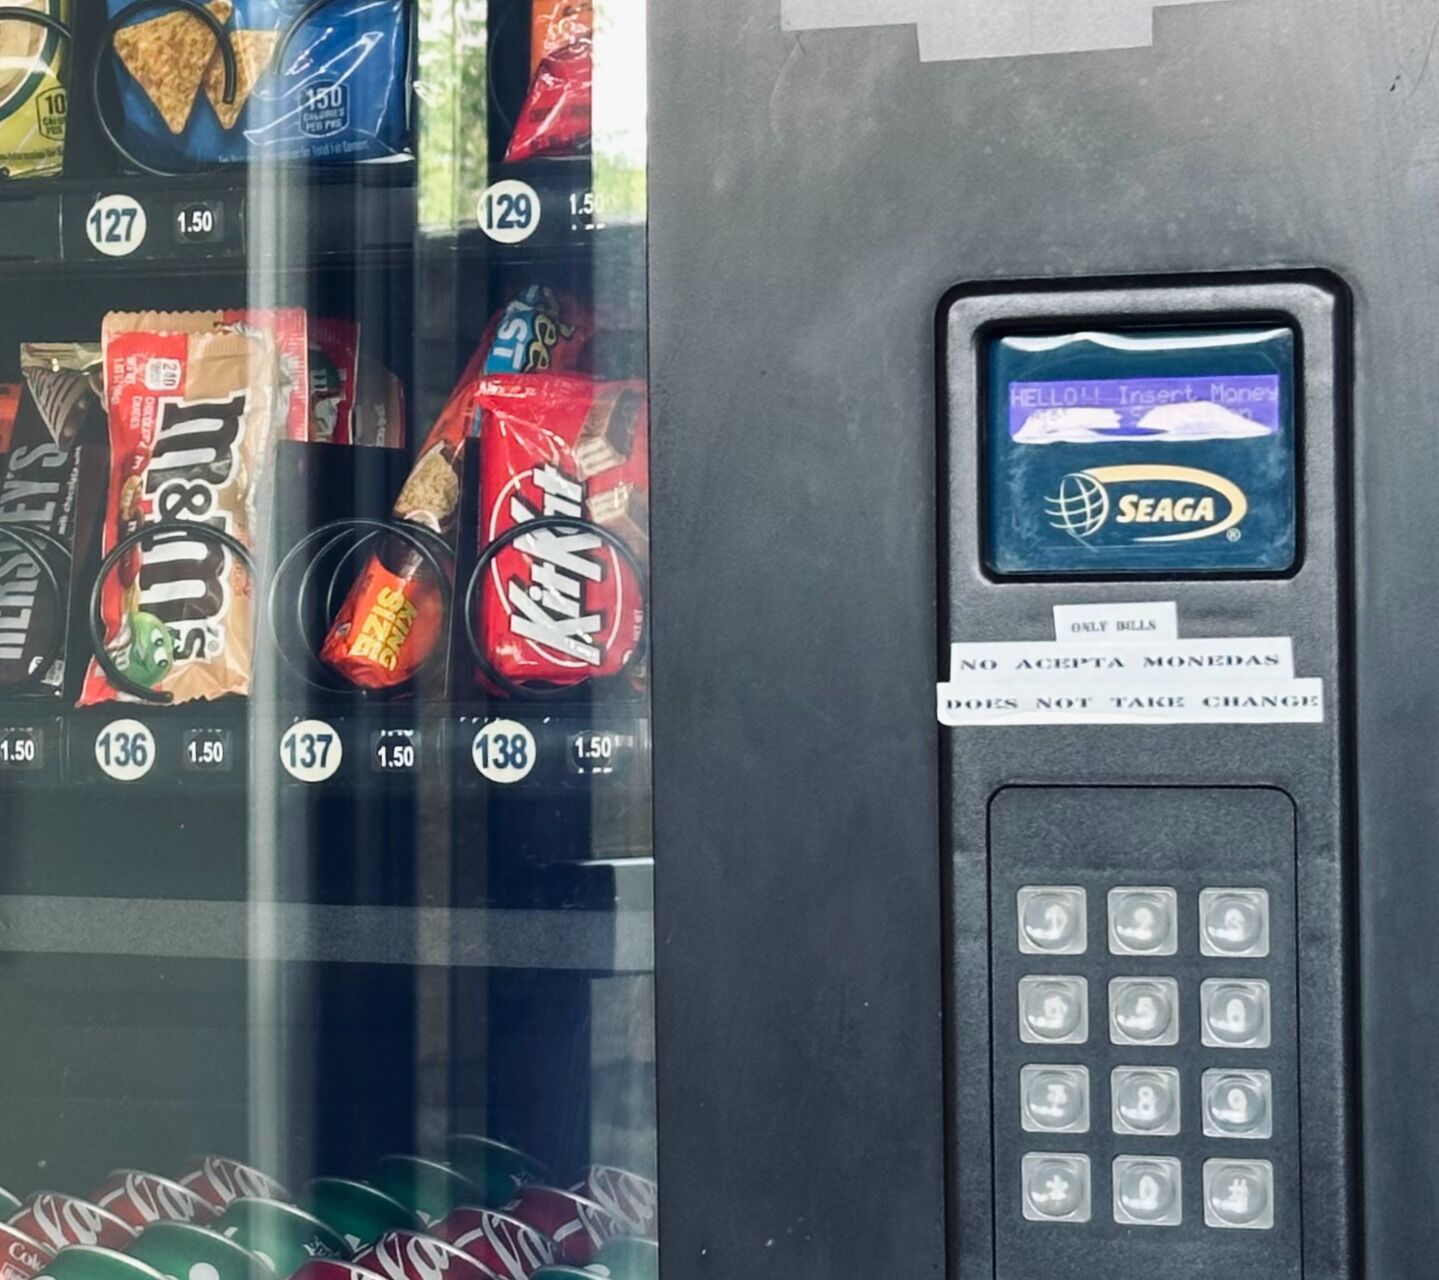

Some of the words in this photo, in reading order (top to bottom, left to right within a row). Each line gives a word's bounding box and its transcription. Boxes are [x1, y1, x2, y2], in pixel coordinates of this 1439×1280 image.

[178, 210, 213, 232] 1.50
[485, 193, 532, 229] 129
[90, 207, 138, 243] 127
[1119, 384, 1197, 407] Insert
[1210, 382, 1280, 405] Money
[1116, 494, 1215, 524] SEAGA
[1070, 621, 1108, 633] ONLY
[1115, 619, 1158, 633] BILLS
[960, 658, 998, 671] NO
[1016, 656, 1126, 670] ACEPTA
[1143, 653, 1281, 669] MONEDAS
[946, 698, 1019, 710] DOES
[1035, 698, 1093, 710] NOT
[1110, 696, 1185, 709] TAKE
[1202, 695, 1320, 708] CHANGE
[0, 740, 35, 761] 1.50
[98, 731, 148, 768] 136
[188, 740, 224, 763] 1.50
[282, 732, 334, 769] 137
[377, 745, 415, 768] 1.50
[475, 732, 529, 769] 138
[574, 736, 612, 759] 1.50
